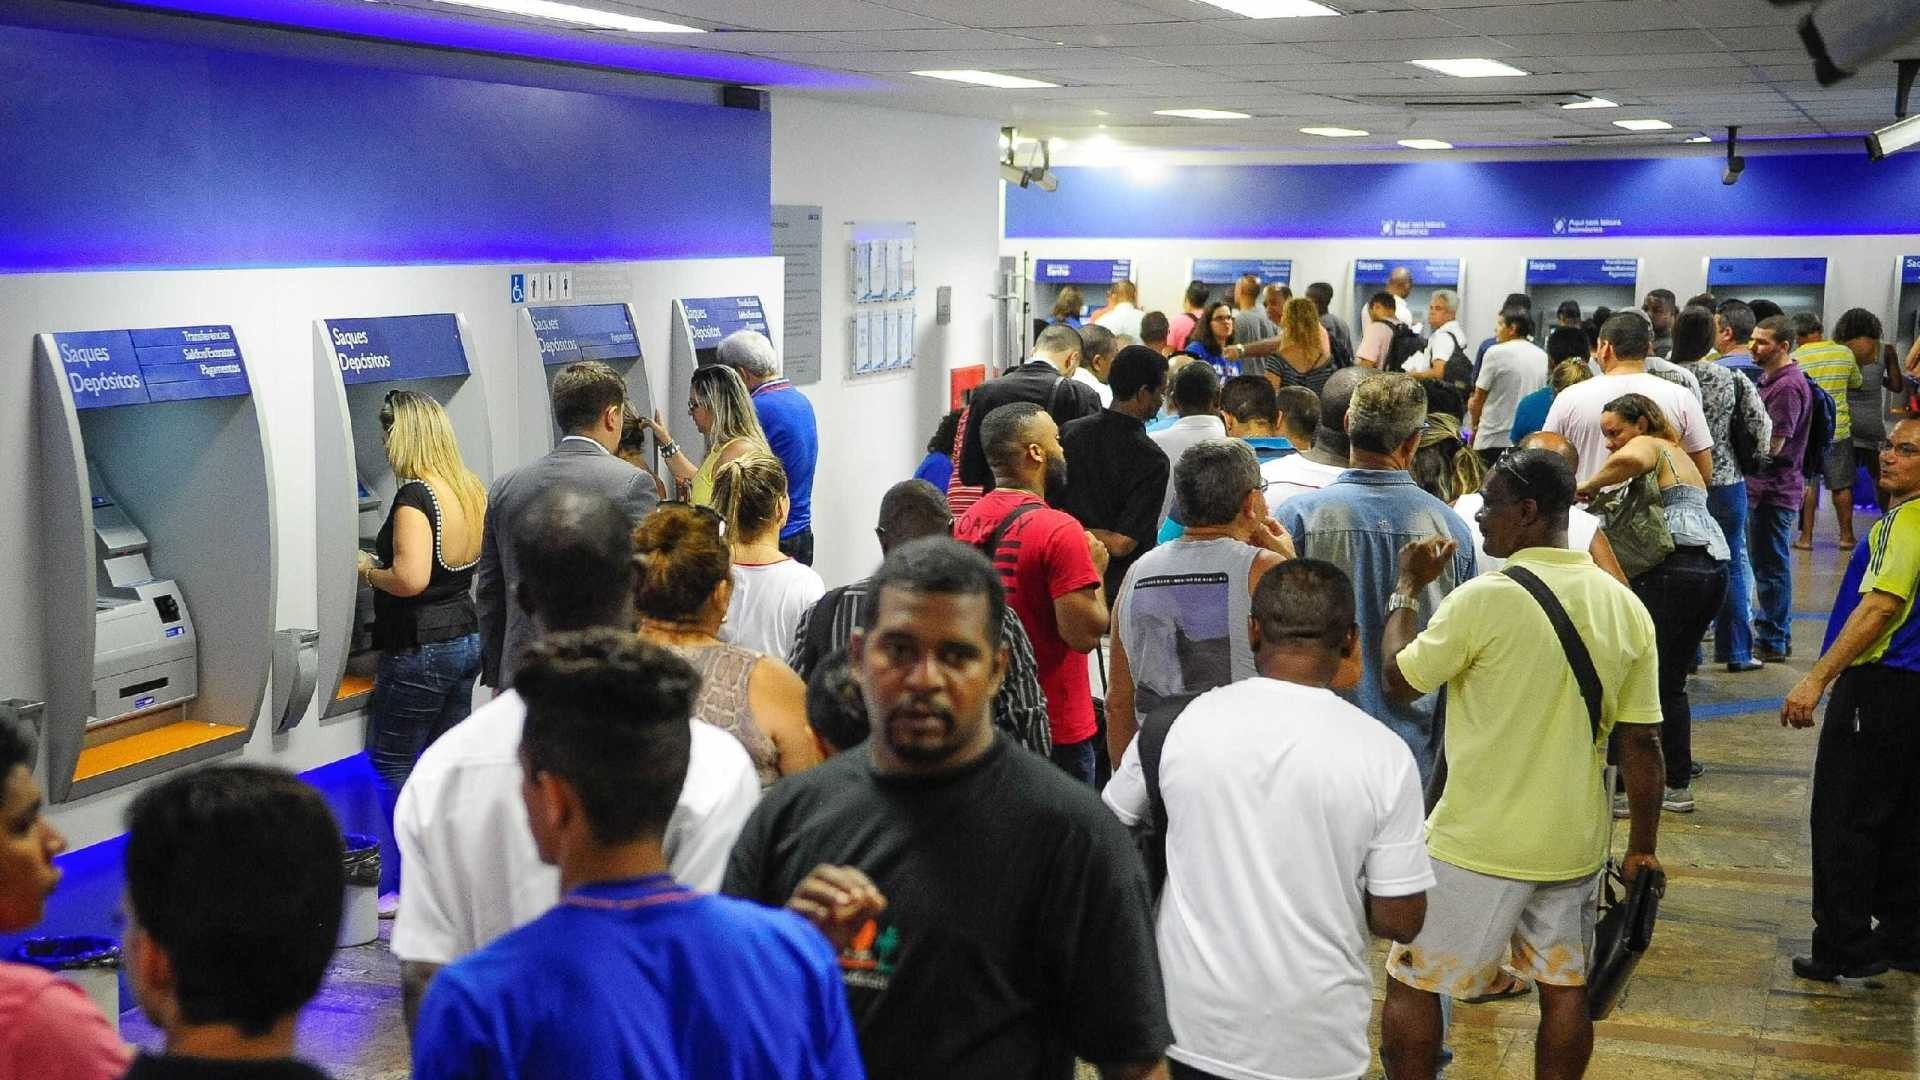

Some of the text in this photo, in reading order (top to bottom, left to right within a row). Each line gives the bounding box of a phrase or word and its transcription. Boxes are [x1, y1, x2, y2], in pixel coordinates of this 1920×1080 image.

[531, 316, 560, 335] Saques
[332, 327, 369, 349] Saques
[537, 337, 578, 357] Depósitos
[62, 344, 110, 368] Saques
[338, 352, 391, 374] Depósitos
[69, 372, 140, 396] Depósitos
